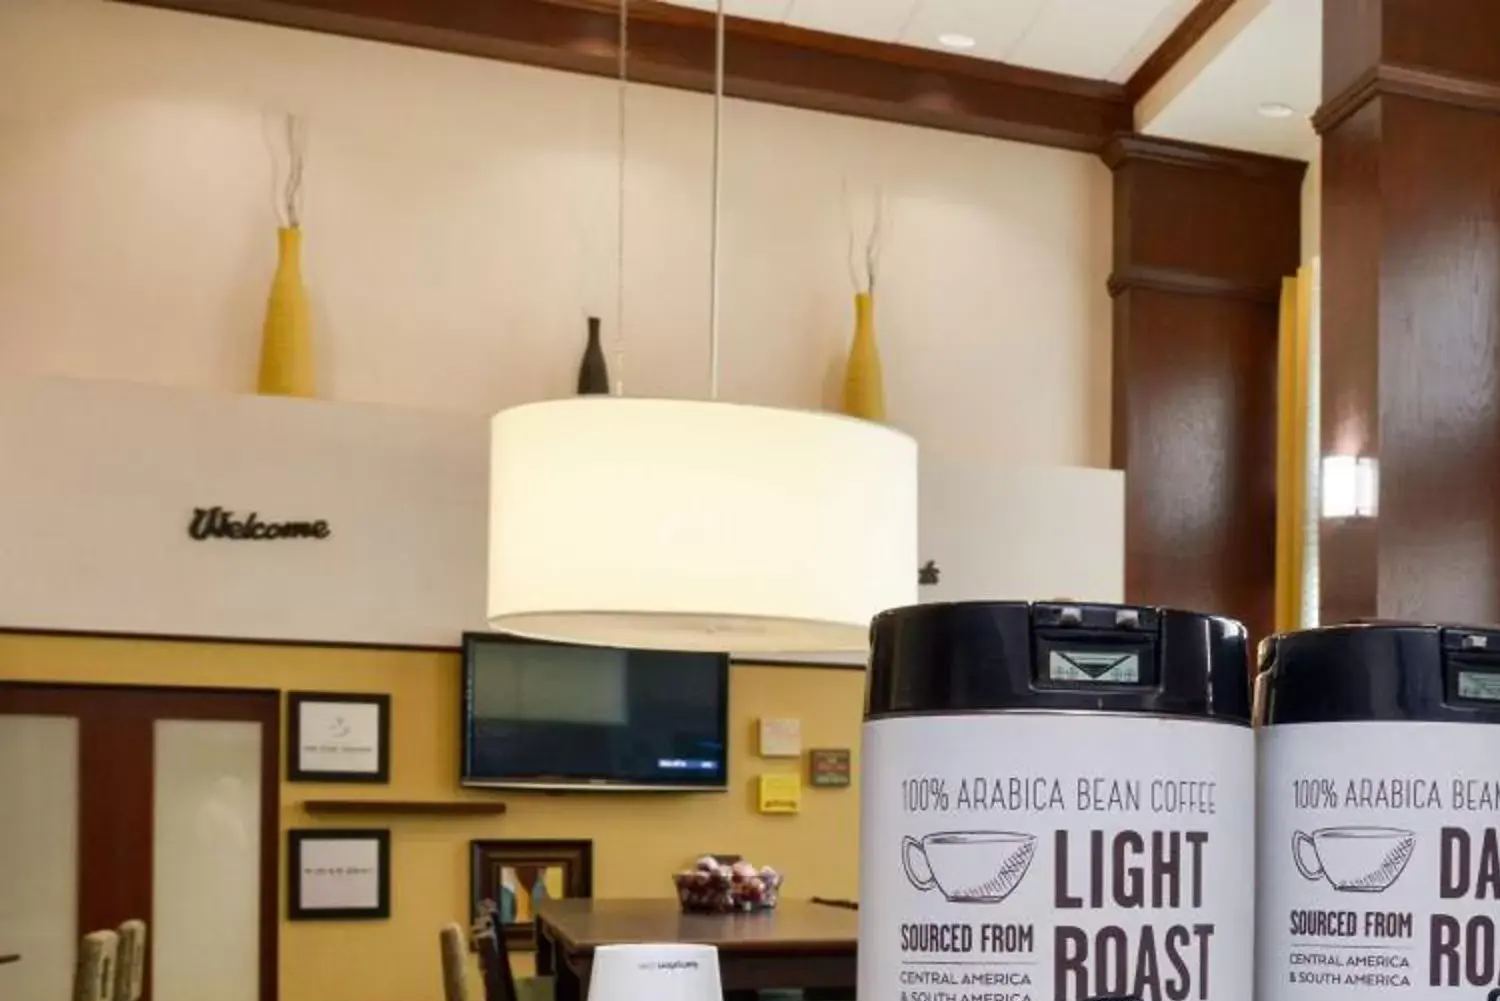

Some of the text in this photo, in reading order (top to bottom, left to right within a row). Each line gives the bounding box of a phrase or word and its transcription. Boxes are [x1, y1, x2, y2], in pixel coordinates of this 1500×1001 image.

[188, 505, 332, 541] Welcome
[901, 777, 1217, 814] 100% ARABICA BEAN COFFEE
[1292, 778, 1338, 809] 100%
[1345, 779, 1442, 810] ARABICA
[1054, 829, 1209, 909] LIGHT
[900, 923, 1034, 953] SOURCED FROM
[1289, 910, 1413, 939] SOURCED FROM
[1289, 952, 1410, 968] CENTRAL AMERICA
[900, 970, 1032, 987] CENTRAL AMERICA
[1289, 971, 1411, 987] & SOUTH AMERICA
